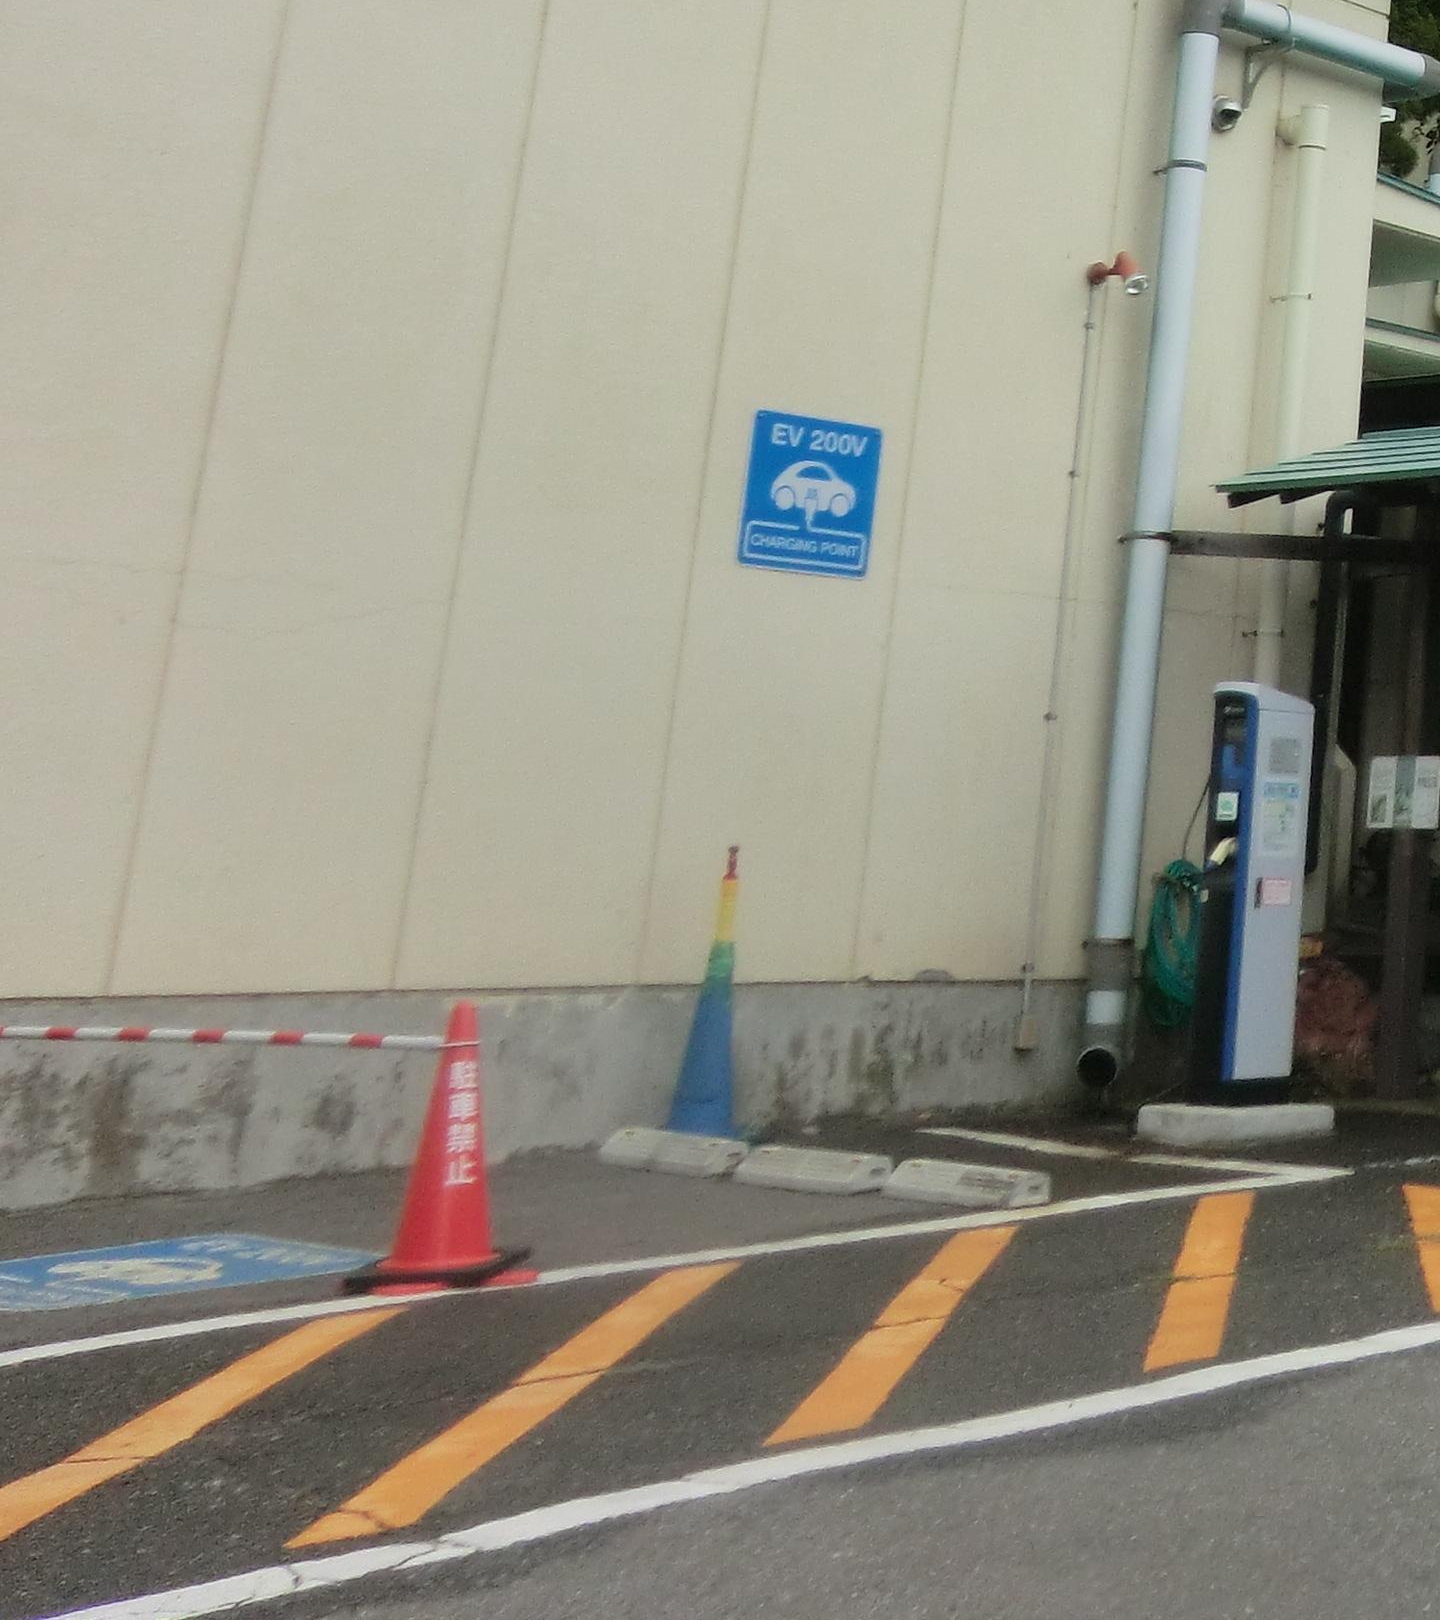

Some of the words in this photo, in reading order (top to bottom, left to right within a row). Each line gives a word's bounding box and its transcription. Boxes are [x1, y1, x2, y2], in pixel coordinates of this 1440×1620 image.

[771, 423, 803, 447] EV
[809, 430, 868, 457] 200V
[751, 534, 817, 553] CHARGING
[820, 541, 859, 556] POINT
